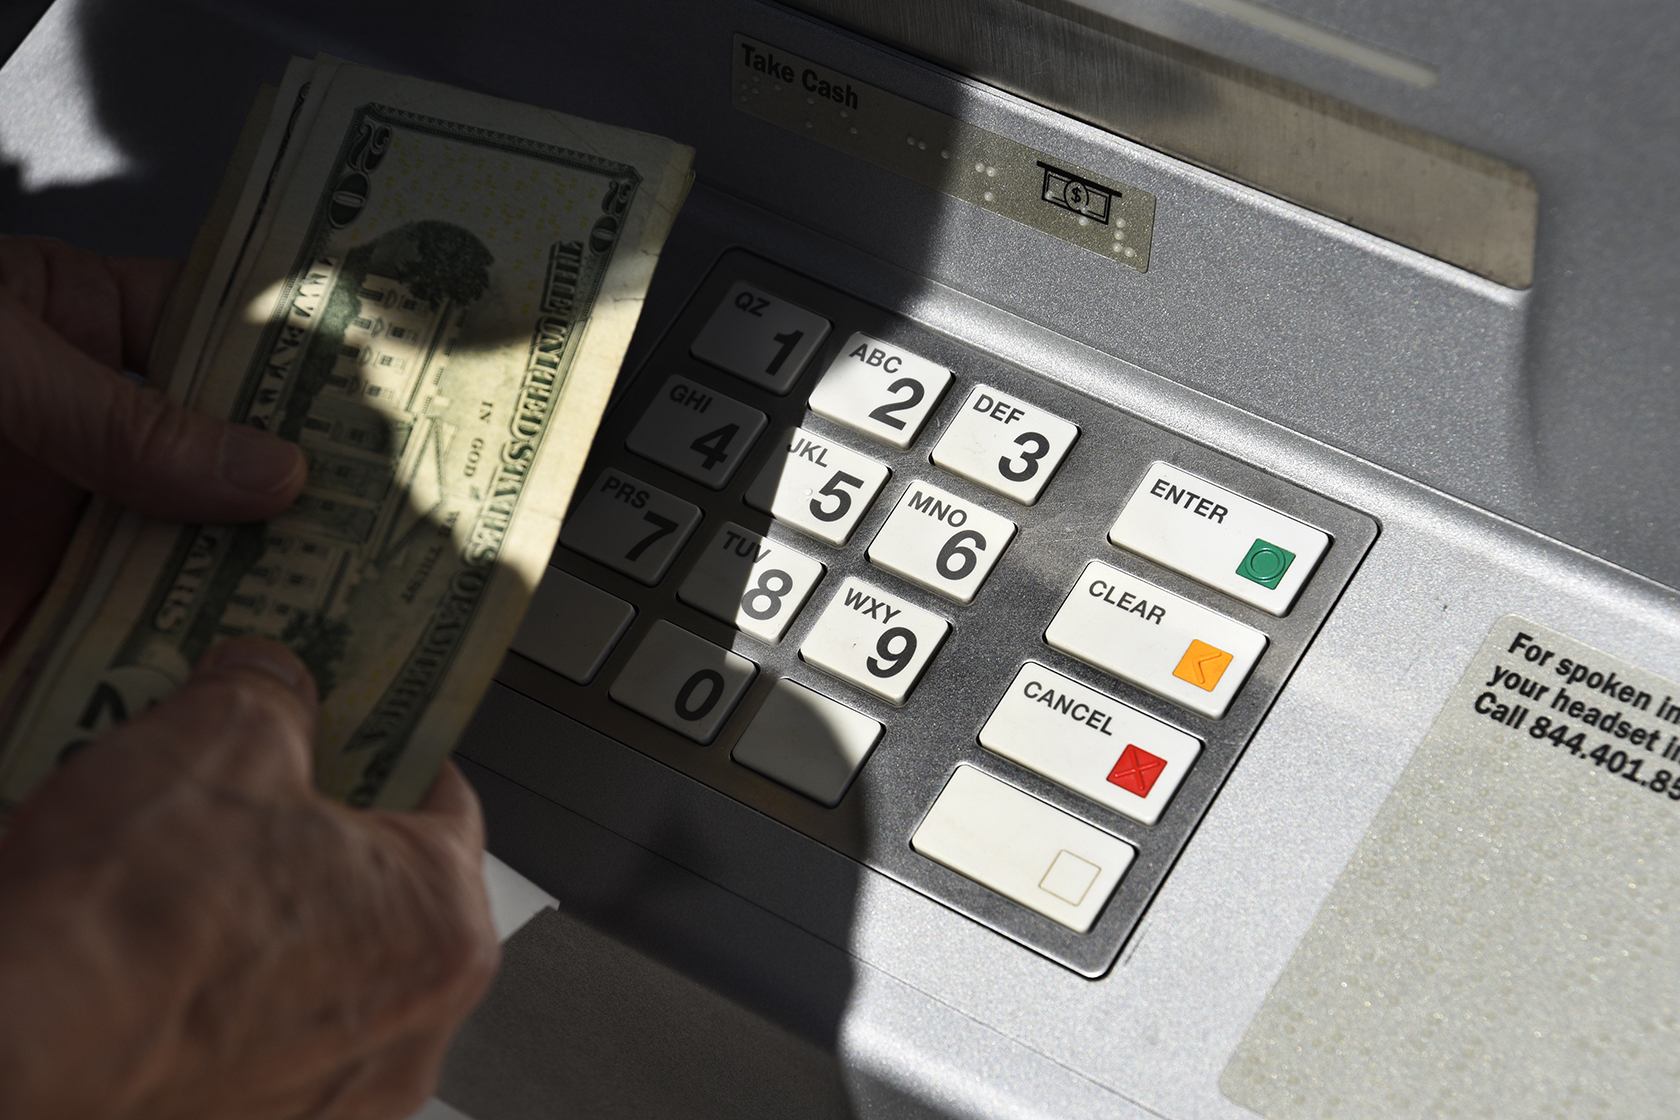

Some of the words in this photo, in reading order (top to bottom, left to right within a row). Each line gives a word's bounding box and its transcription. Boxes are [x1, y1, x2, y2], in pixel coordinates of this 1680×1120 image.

[740, 43, 795, 83] Take
[801, 67, 860, 110] Cash
[733, 290, 770, 318] QZ
[765, 329, 804, 377] 1
[848, 343, 903, 375] ABC
[479, 400, 493, 424] IN
[669, 384, 712, 413] GHI
[868, 377, 926, 431] 2
[972, 394, 1025, 426] DEF
[463, 436, 485, 478] GOD
[689, 423, 741, 471] 4
[787, 442, 829, 469] JKL
[997, 431, 1051, 483] 3
[600, 475, 650, 510] PRS
[809, 470, 865, 523] 5
[907, 490, 968, 528] MNO
[1149, 478, 1230, 525] ENTER
[624, 510, 679, 563] 7
[722, 530, 771, 564] TUV
[935, 529, 987, 581] 6
[740, 568, 794, 622] 8
[843, 586, 901, 626] WXY
[1088, 579, 1168, 626] CLEAR
[866, 626, 918, 679] 9
[1507, 631, 1555, 667] For
[1555, 657, 1653, 711] spoken
[675, 668, 726, 720] 0
[1023, 680, 1114, 737] CANCEL
[1474, 691, 1530, 730] Call
[1486, 665, 1550, 701] your
[1550, 687, 1661, 752] headset
